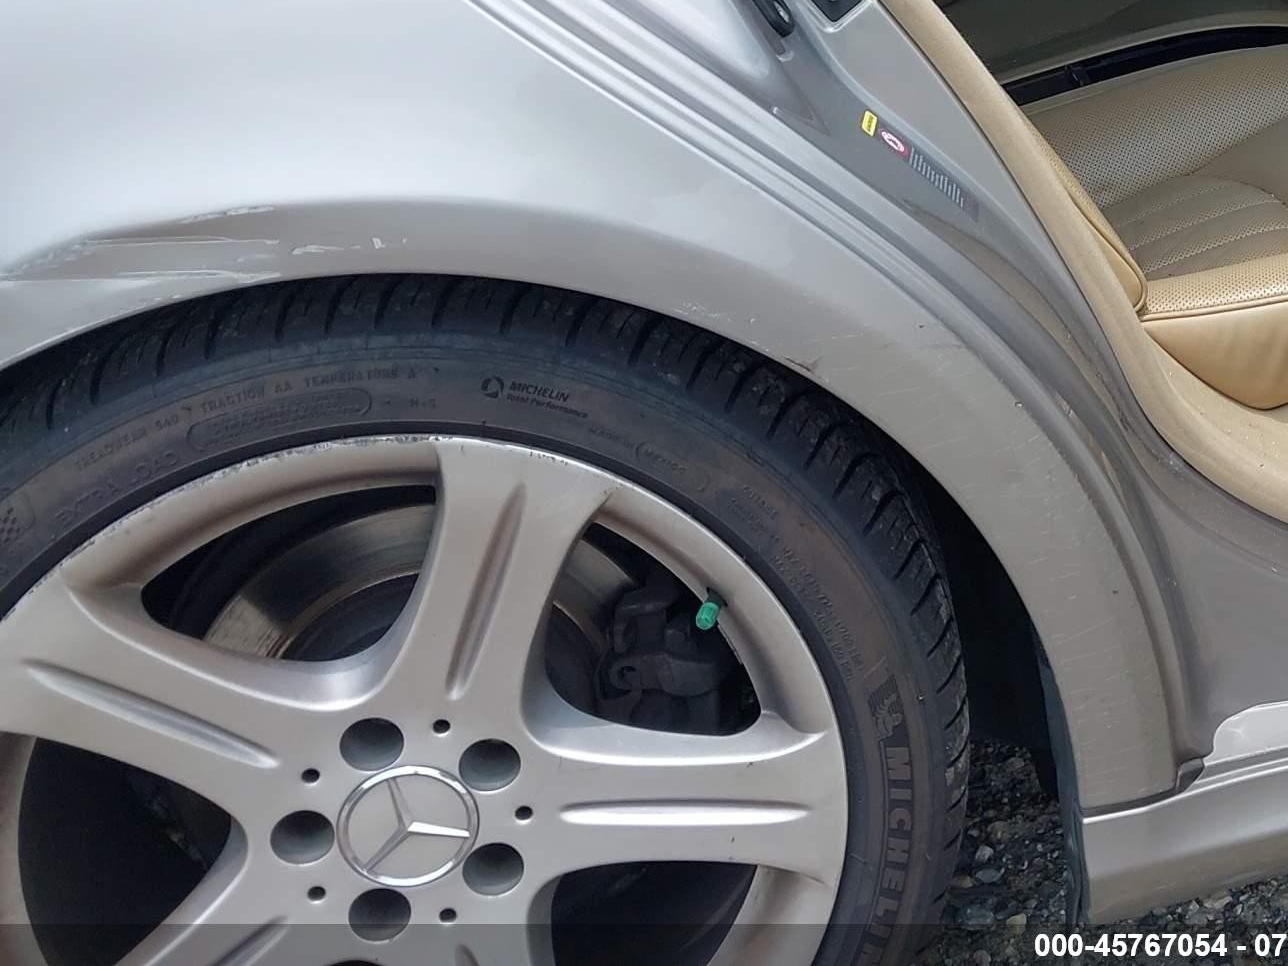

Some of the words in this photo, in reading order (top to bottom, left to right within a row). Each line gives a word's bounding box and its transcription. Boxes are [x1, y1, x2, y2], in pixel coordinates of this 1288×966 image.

[199, 384, 265, 414] TRACTION
[274, 380, 293, 395] AA
[304, 366, 400, 388] TEMPERATURE
[506, 392, 530, 406] Total
[530, 397, 590, 419] Performance
[508, 381, 572, 403] MICHELIN
[856, 746, 913, 966] MICHELIN
